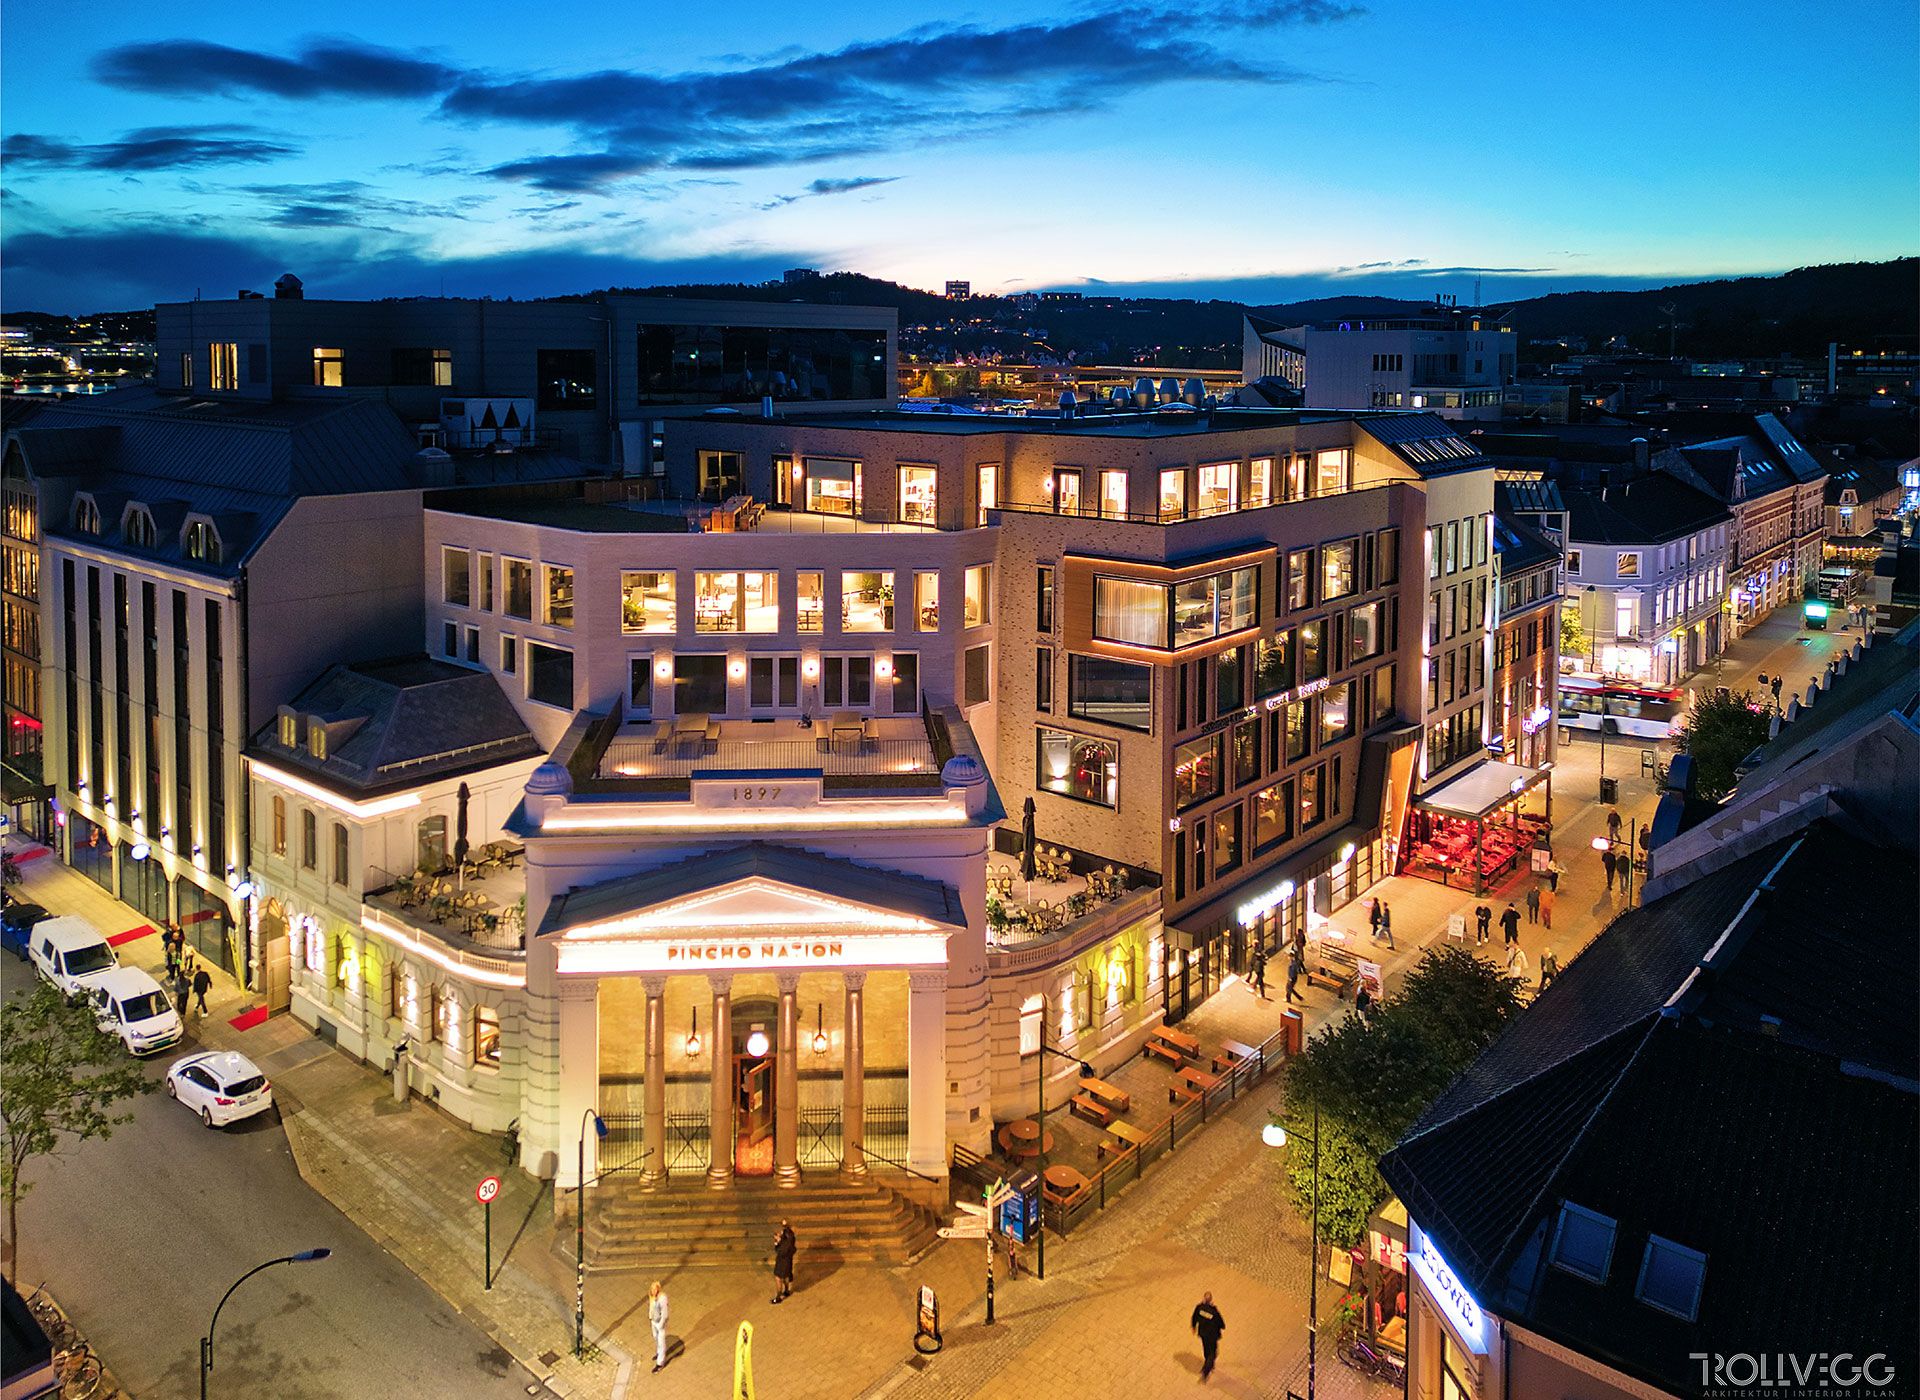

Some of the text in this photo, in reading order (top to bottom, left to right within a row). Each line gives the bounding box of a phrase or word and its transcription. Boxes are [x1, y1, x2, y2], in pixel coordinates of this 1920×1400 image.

[12, 796, 36, 804] HOTEL
[733, 786, 782, 801] 1897
[668, 942, 842, 961] PINCHO NATION
[481, 1182, 496, 1197] 30
